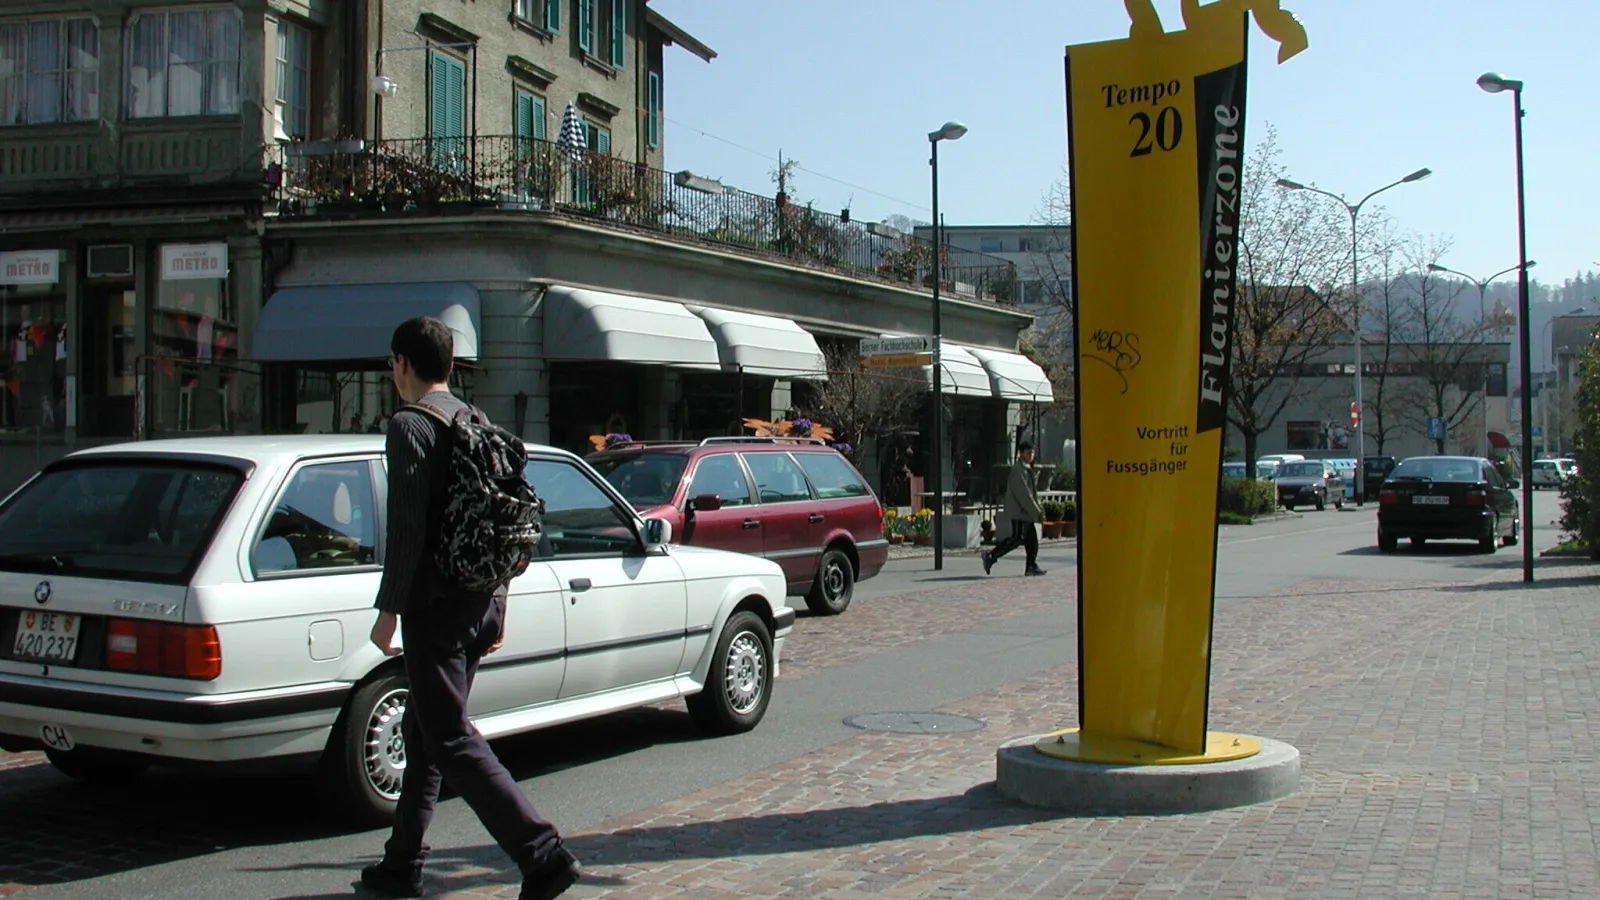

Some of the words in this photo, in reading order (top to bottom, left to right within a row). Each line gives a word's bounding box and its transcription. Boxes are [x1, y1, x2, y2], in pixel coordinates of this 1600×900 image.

[1102, 79, 1181, 108] Tempo
[1128, 106, 1183, 158] 20
[172, 256, 218, 272] METRO
[1201, 104, 1240, 407] Flanierzone
[6, 262, 50, 277] METRO
[1136, 425, 1188, 440] Vortritt
[1170, 442, 1188, 456] für
[1106, 459, 1188, 475] Fussgänger
[40, 613, 56, 632] BE
[16, 632, 43, 658] 420
[45, 635, 75, 660] 237
[42, 724, 70, 749] CH
